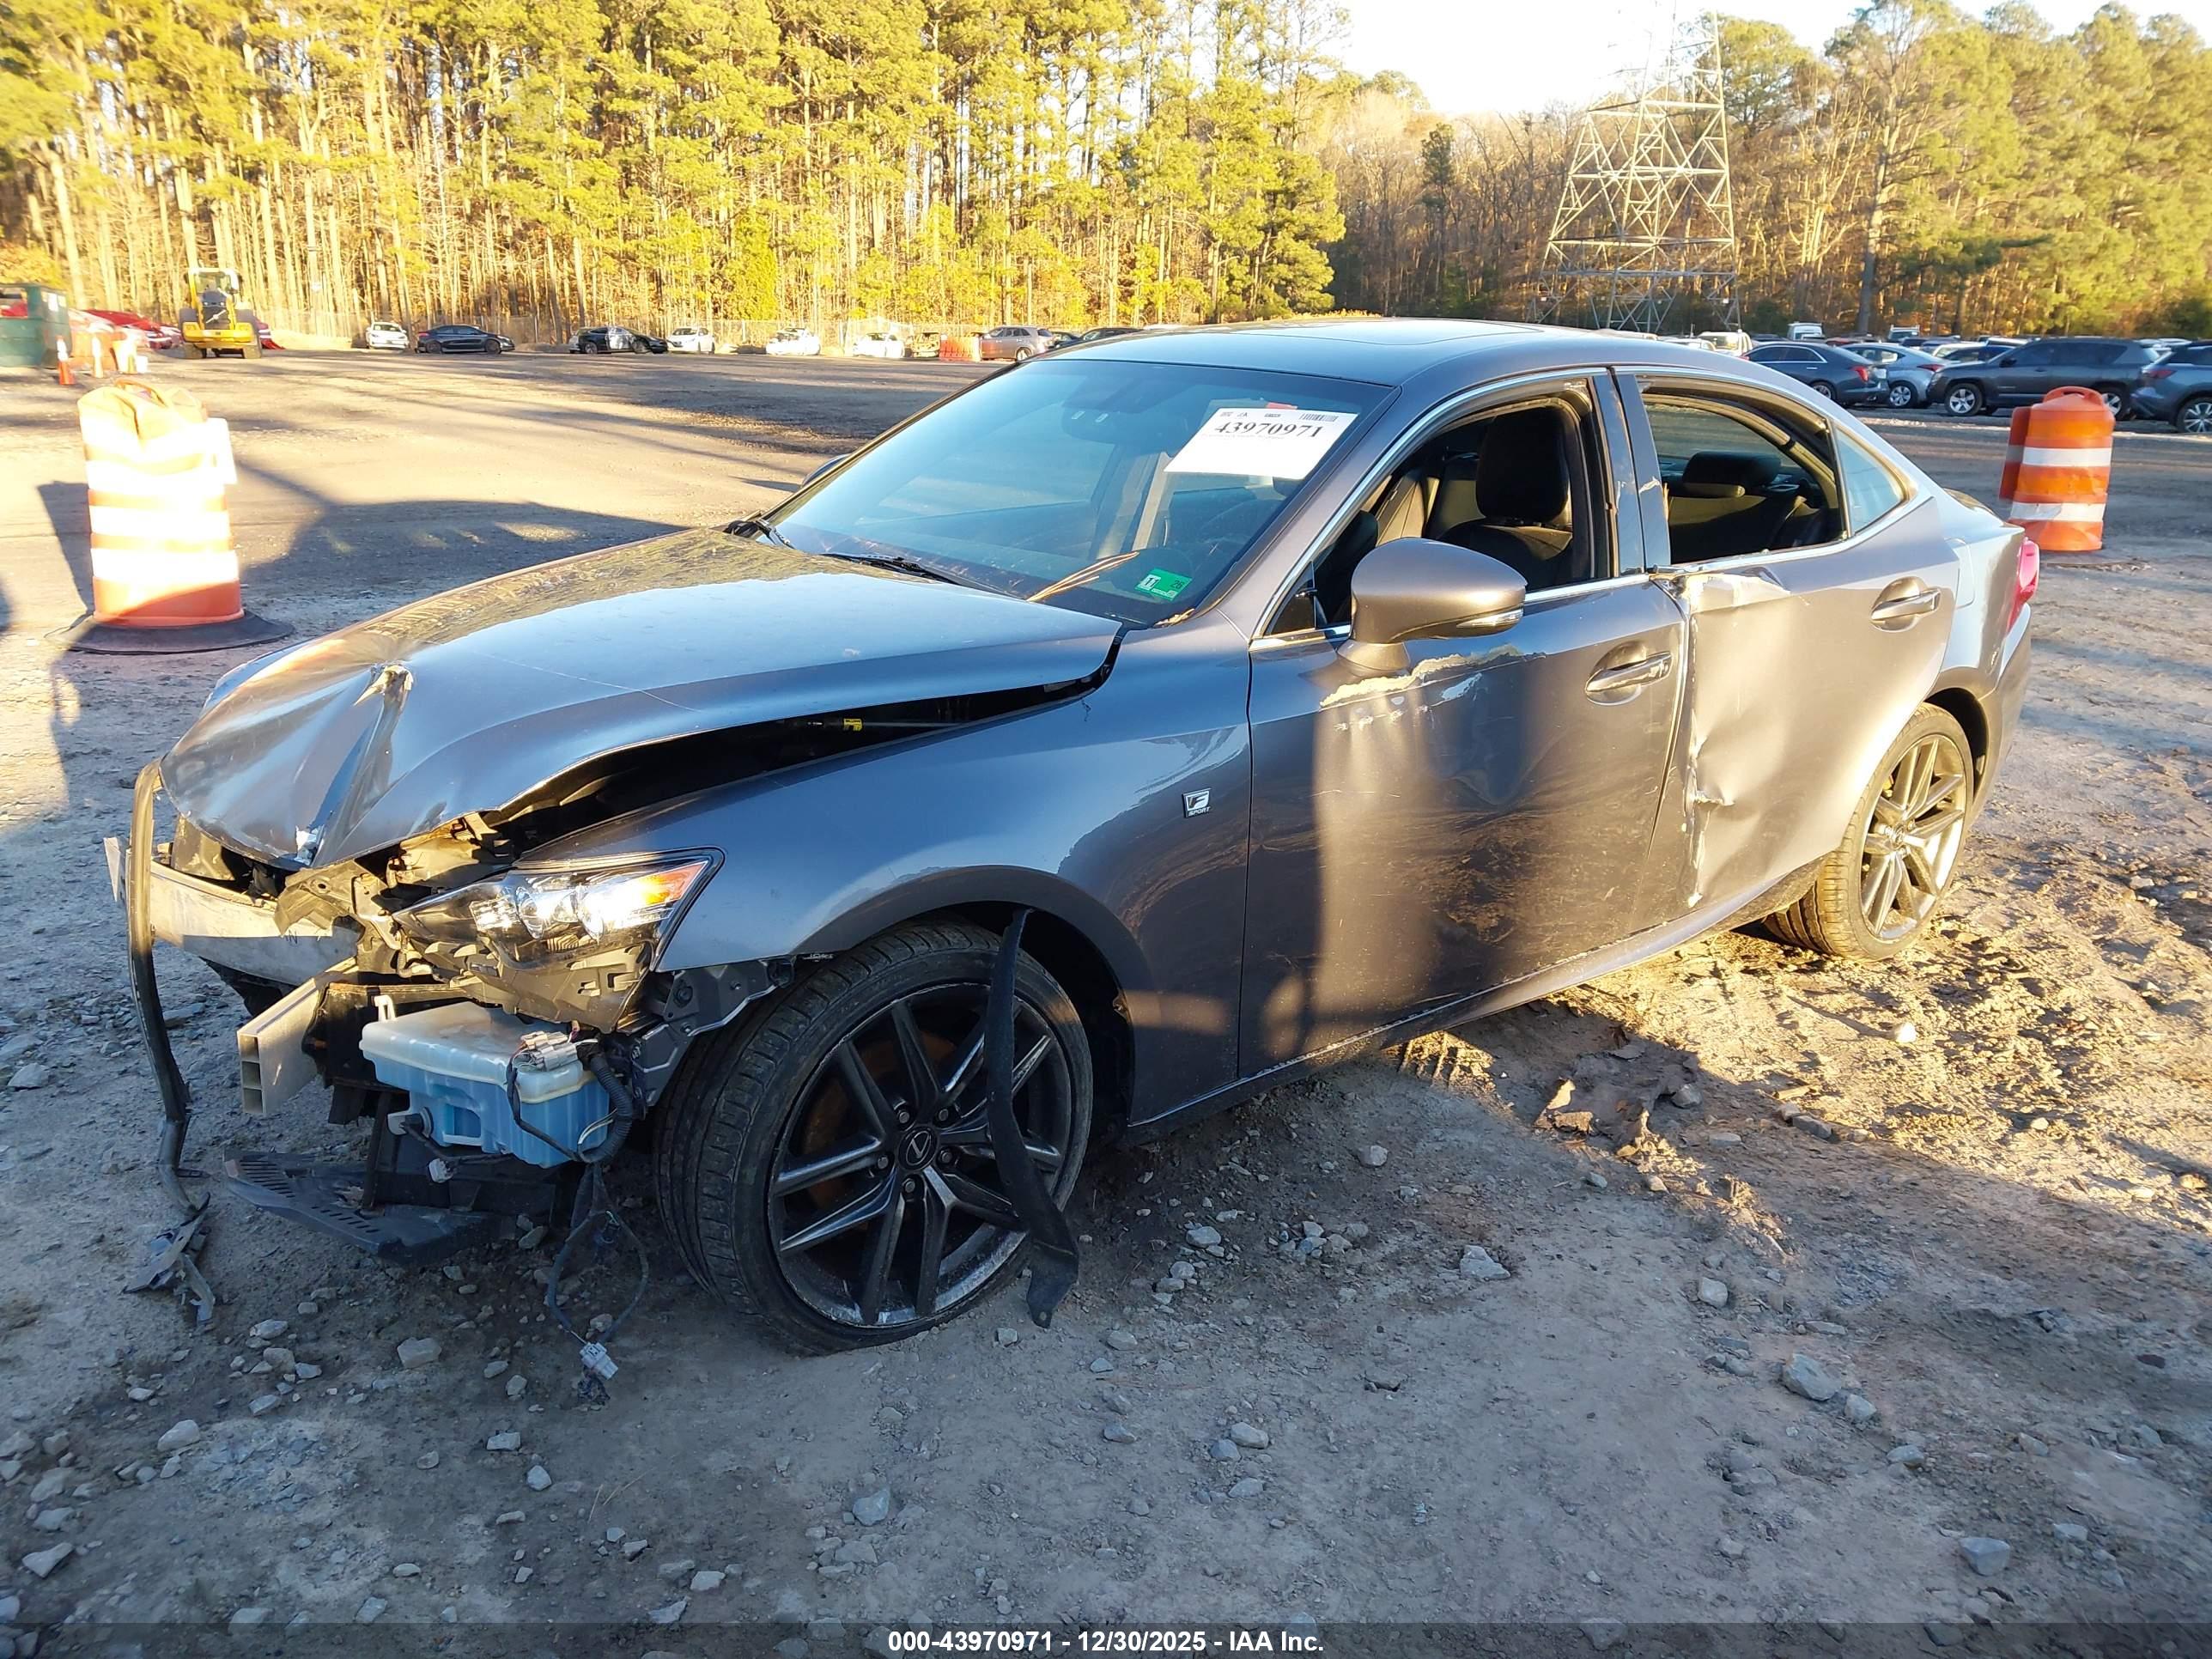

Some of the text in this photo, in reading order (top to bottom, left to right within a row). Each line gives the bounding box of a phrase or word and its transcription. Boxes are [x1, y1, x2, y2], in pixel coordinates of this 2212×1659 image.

[1214, 422, 1324, 438] 43970971
[1144, 577, 1159, 588] 11
[1188, 805, 1211, 817] SPORT
